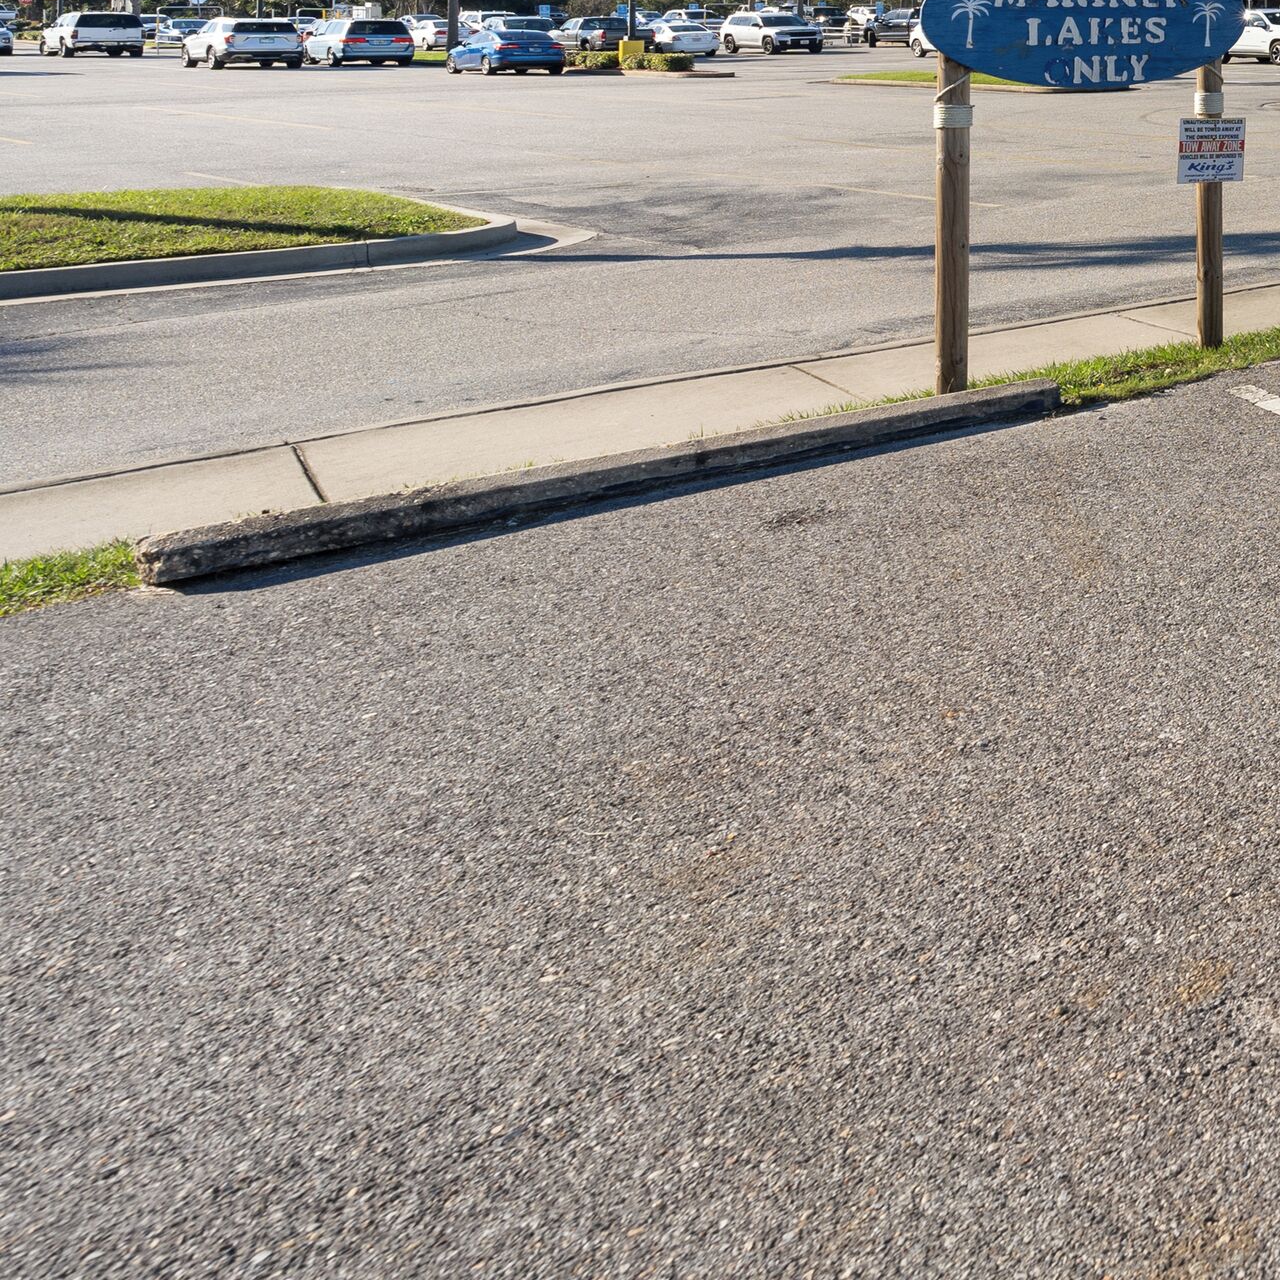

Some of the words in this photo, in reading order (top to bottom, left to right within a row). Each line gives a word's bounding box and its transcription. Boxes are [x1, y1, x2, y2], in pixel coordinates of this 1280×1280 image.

[1182, 142, 1199, 152] TOW
[1200, 141, 1221, 152] AWAY
[1223, 141, 1242, 151] ZONE
[1187, 160, 1235, 174] King's
